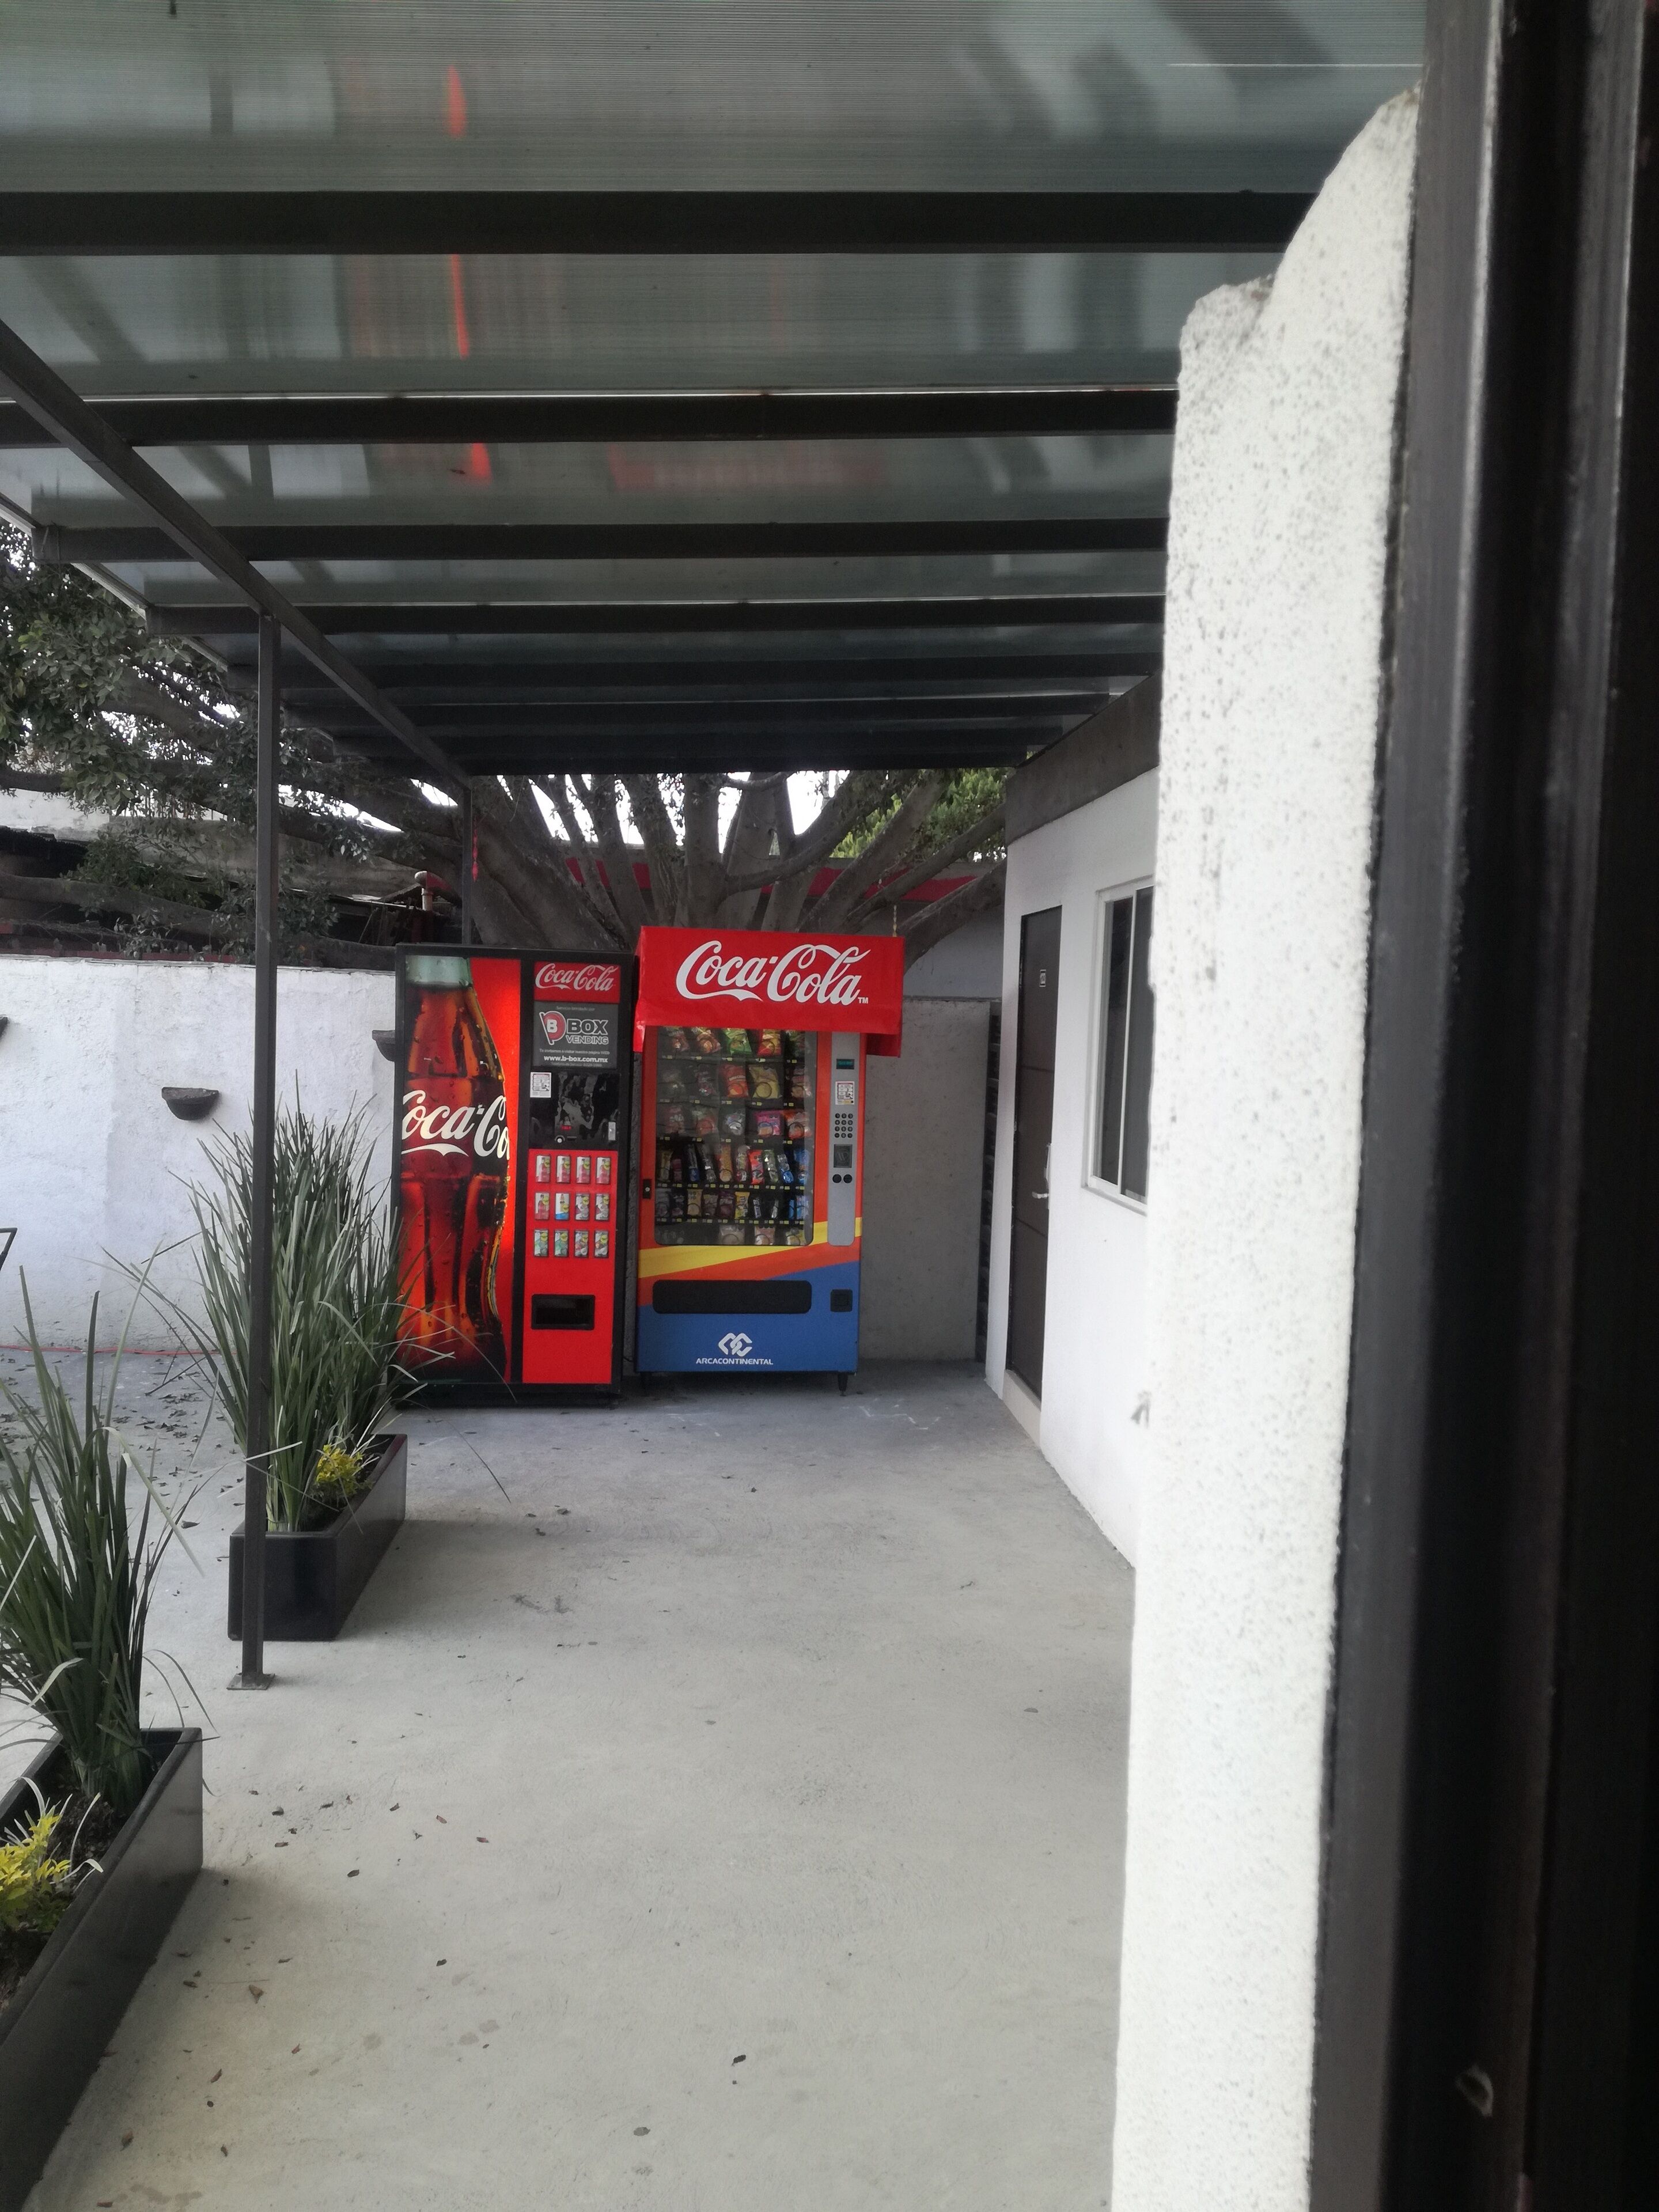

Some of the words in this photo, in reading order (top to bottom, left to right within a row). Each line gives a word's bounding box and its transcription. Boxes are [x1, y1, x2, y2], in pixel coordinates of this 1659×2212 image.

[535, 963, 618, 991] Coca-Cola
[676, 940, 871, 1005] Coca-Cola
[566, 1018, 608, 1035] BOX
[566, 1035, 609, 1044] VENDING
